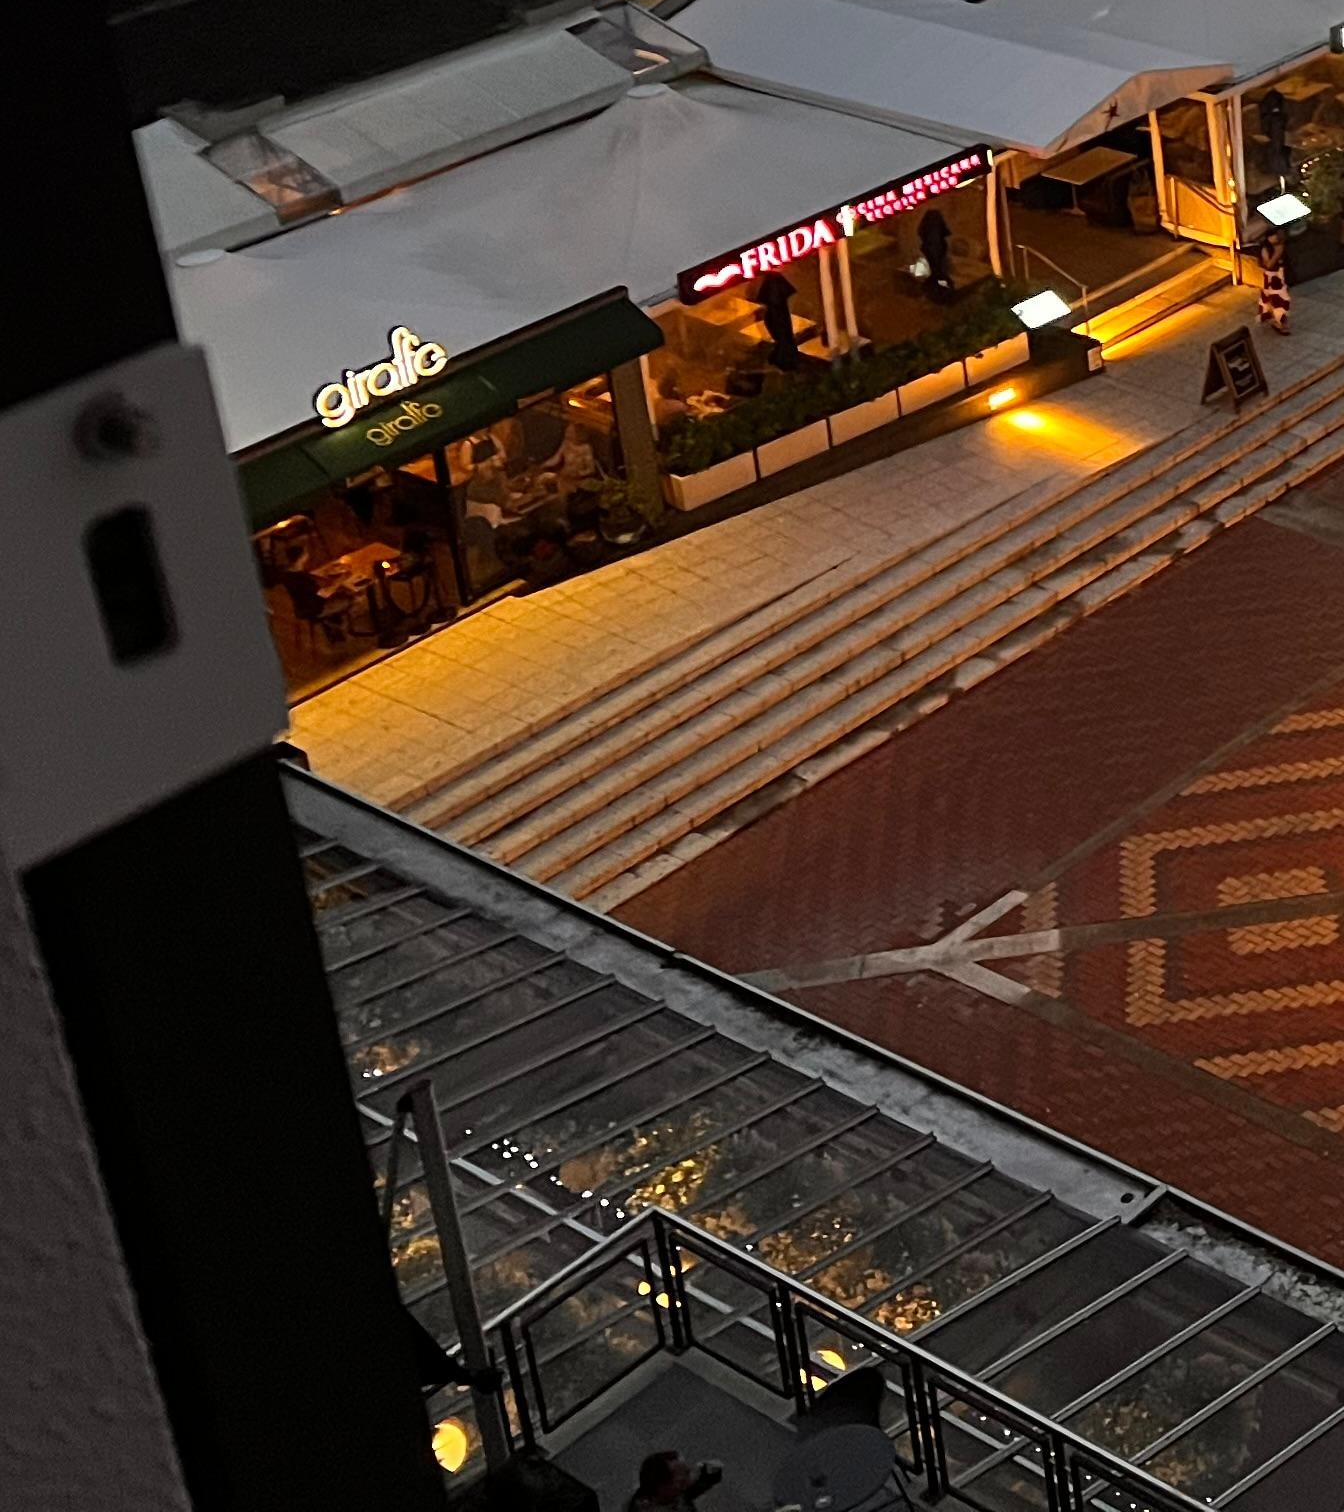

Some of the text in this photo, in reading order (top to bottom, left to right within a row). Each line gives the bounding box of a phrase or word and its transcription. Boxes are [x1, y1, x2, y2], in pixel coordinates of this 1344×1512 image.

[740, 220, 836, 278] FRIDA
[316, 326, 448, 428] giraffe
[367, 400, 443, 446] giraffe
